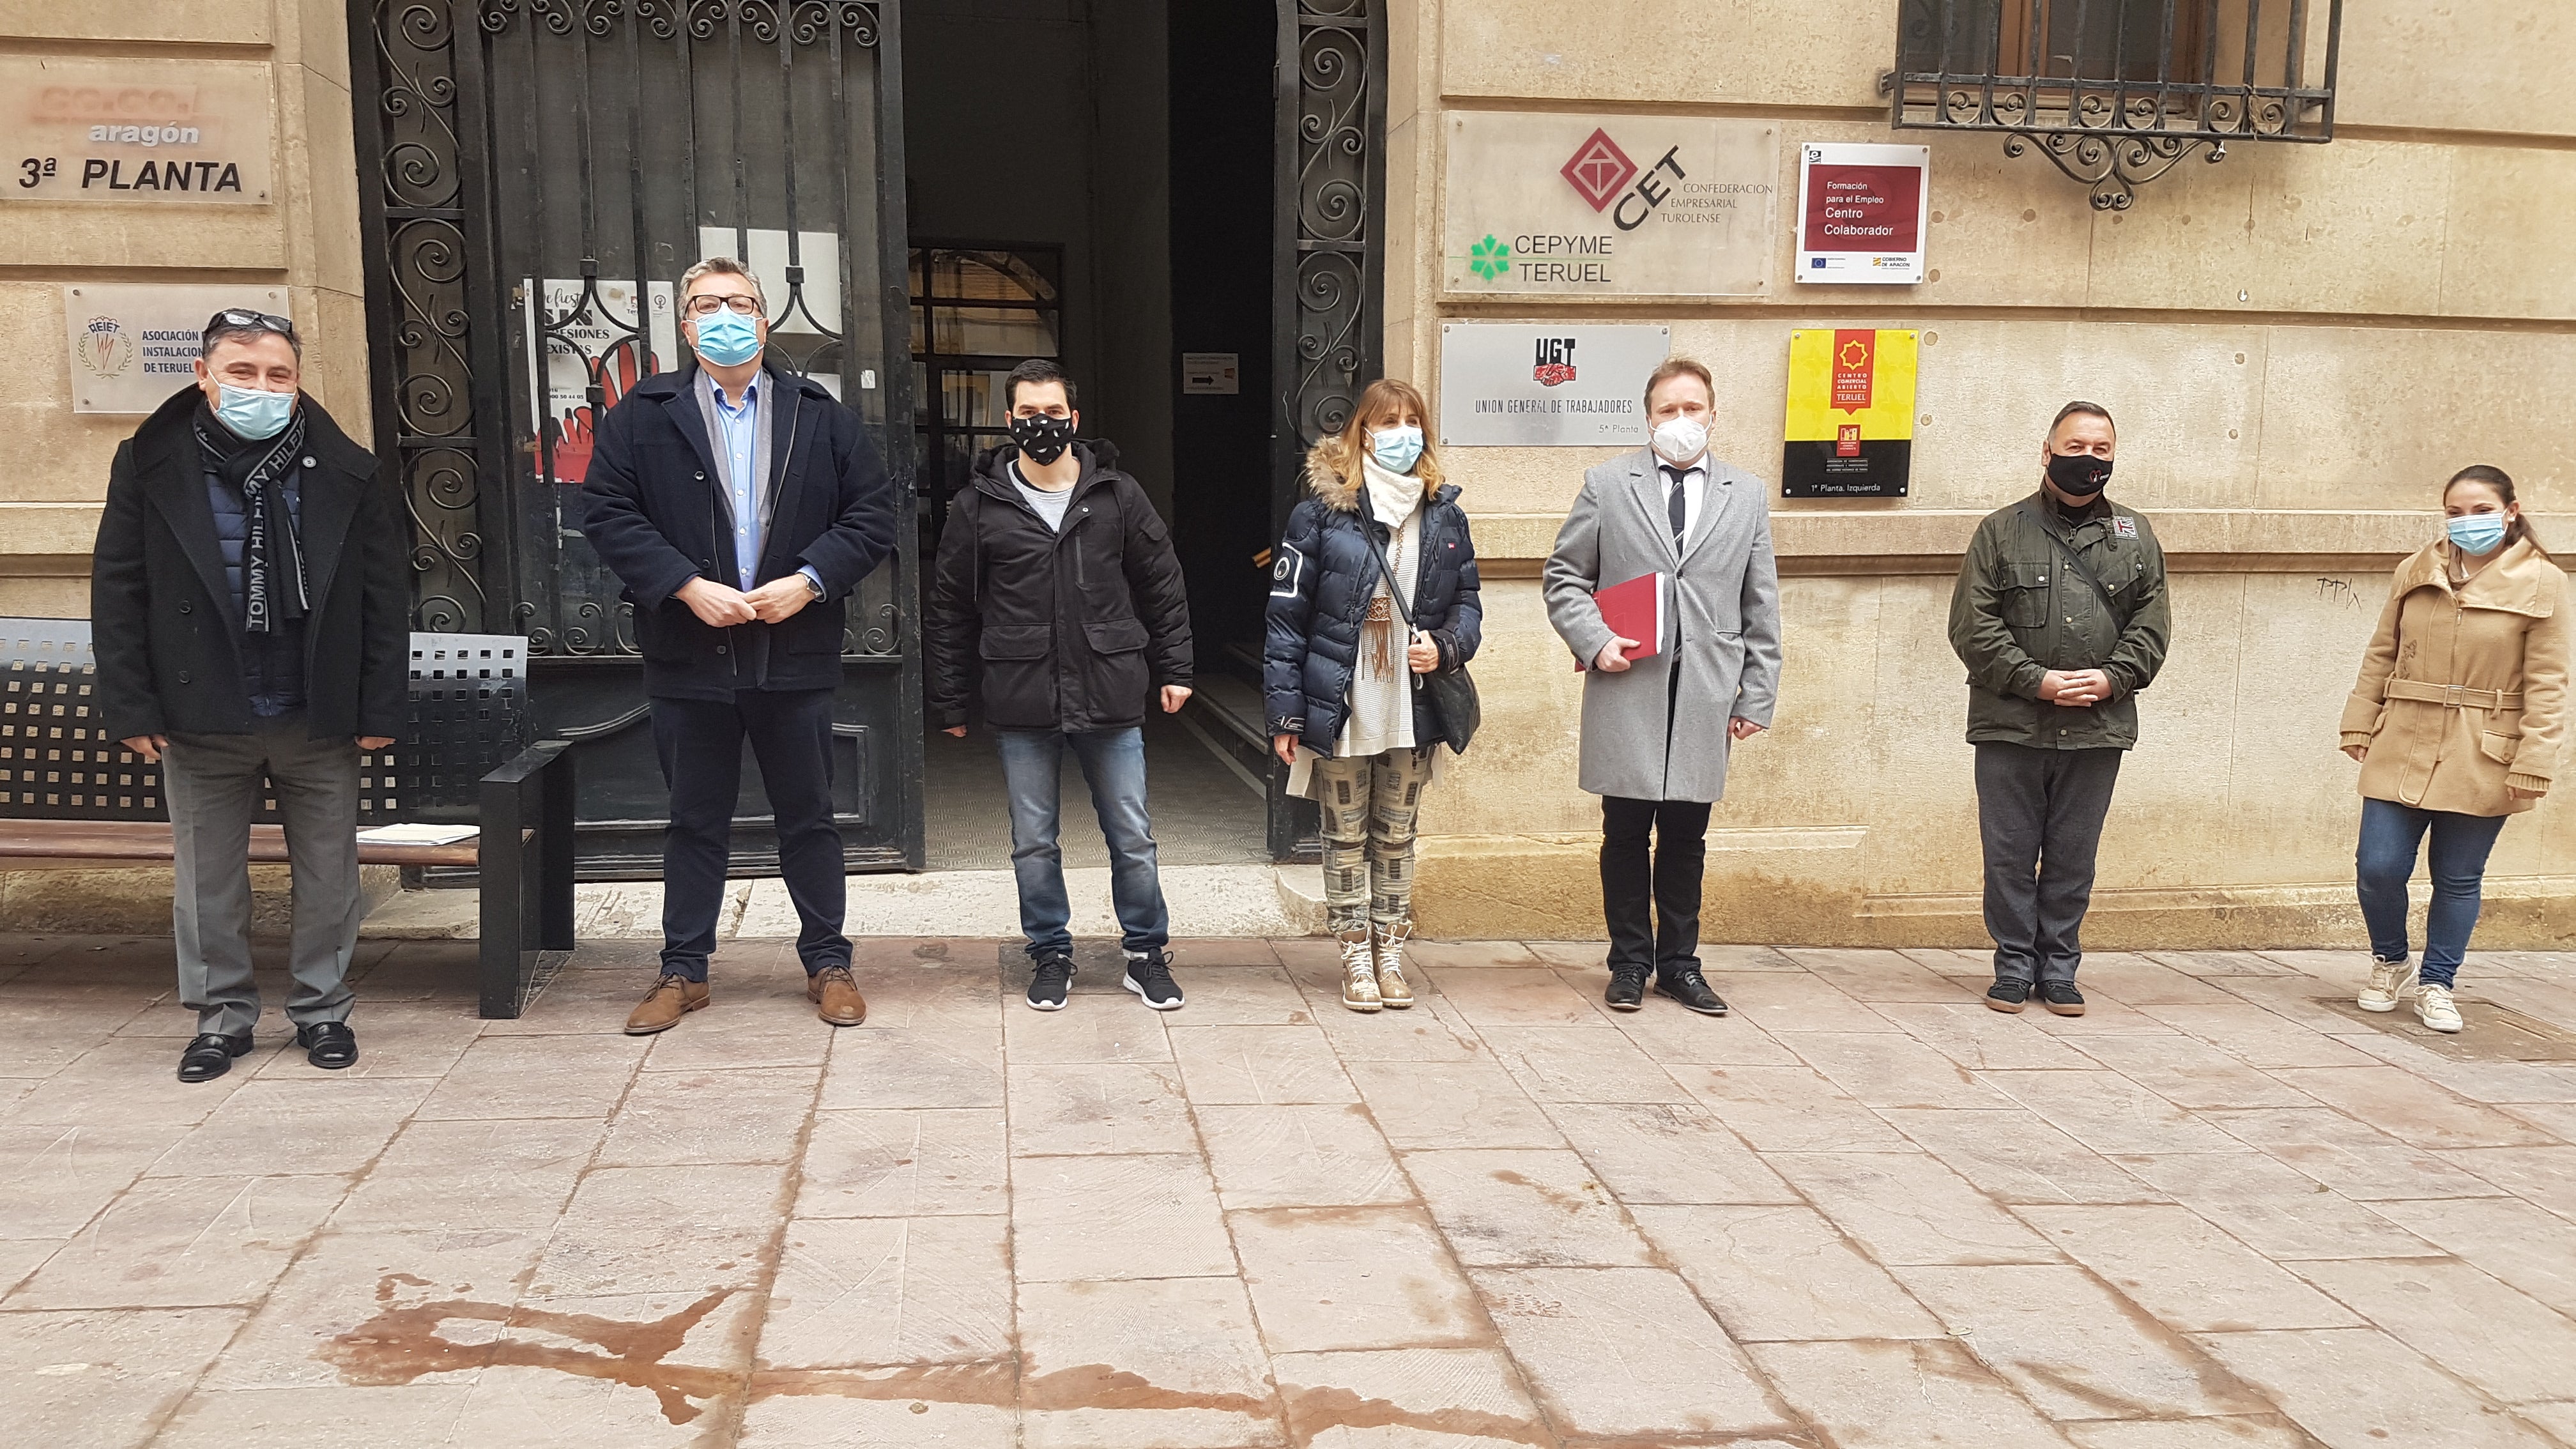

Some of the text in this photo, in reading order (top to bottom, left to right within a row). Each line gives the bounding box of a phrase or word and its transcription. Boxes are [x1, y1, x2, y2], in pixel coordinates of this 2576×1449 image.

[88, 121, 199, 146] aragón
[19, 157, 242, 192] 3ª PLANTA
[1613, 144, 1686, 231] CET
[1683, 183, 1773, 194] CONFEDERACION
[1827, 181, 1867, 190] Formación
[1671, 199, 1737, 209] EMPRESARIAL
[1855, 195, 1884, 204] Empleo
[1660, 213, 1721, 223] TUROLENSE
[1825, 208, 1863, 218] Centro
[1824, 224, 1894, 236] Colaborador
[1515, 235, 1613, 254] CEPYME
[1519, 263, 1611, 282] TERUEL
[555, 288, 583, 307] fiest
[142, 330, 199, 341] ASOCIACIÓN
[1536, 339, 1575, 366] UGT
[144, 363, 194, 373] DE TERUEL
[1475, 400, 1632, 413] UNION GENERAL DE TRABAJADORES
[1612, 425, 1639, 433] Planta
[1847, 484, 1880, 493] Izquierda
[249, 555, 264, 628] TOMMY
